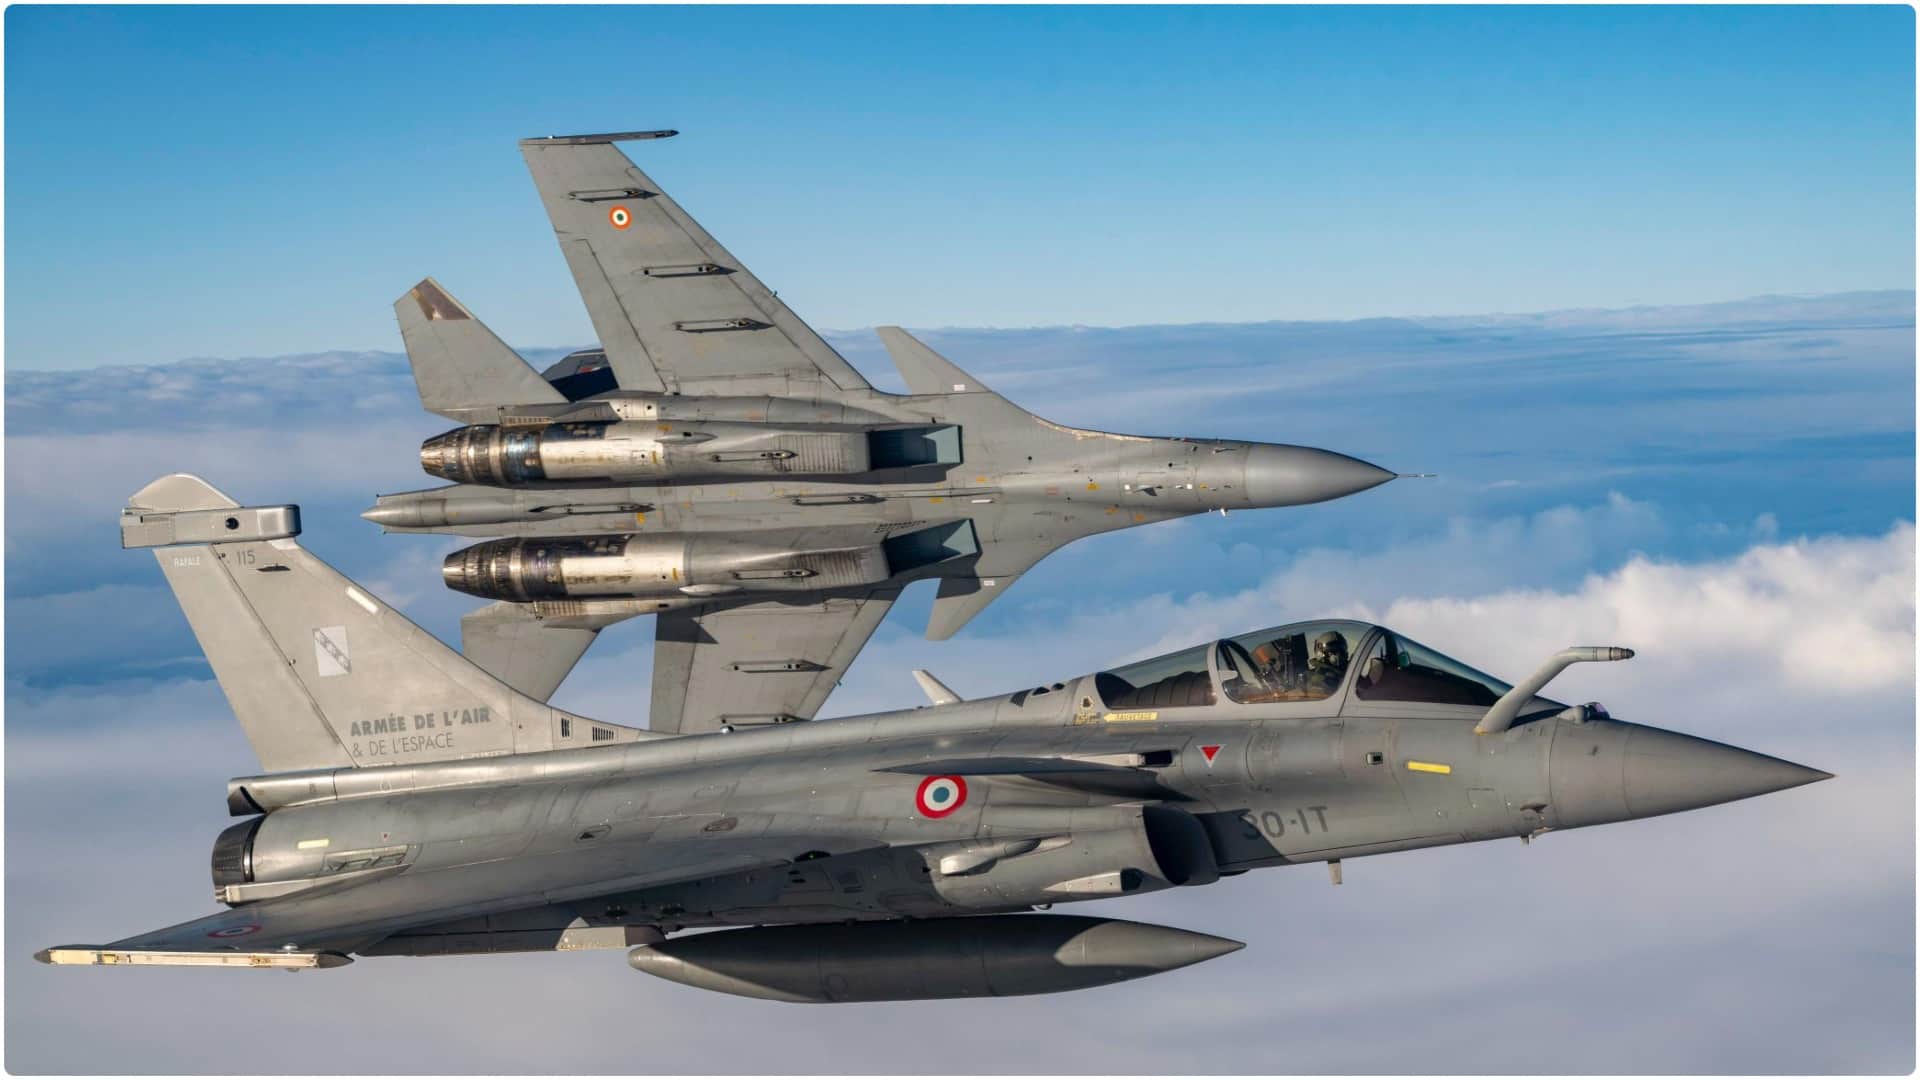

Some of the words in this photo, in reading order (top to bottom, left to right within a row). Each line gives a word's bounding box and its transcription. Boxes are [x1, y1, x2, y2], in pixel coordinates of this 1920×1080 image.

[237, 551, 256, 566] 115
[351, 713, 406, 736] ARMÉE
[414, 713, 435, 730] DE
[443, 707, 491, 727] L'AIR
[352, 743, 363, 758] &
[369, 739, 389, 756] DE
[392, 732, 455, 754] L'ESPACE
